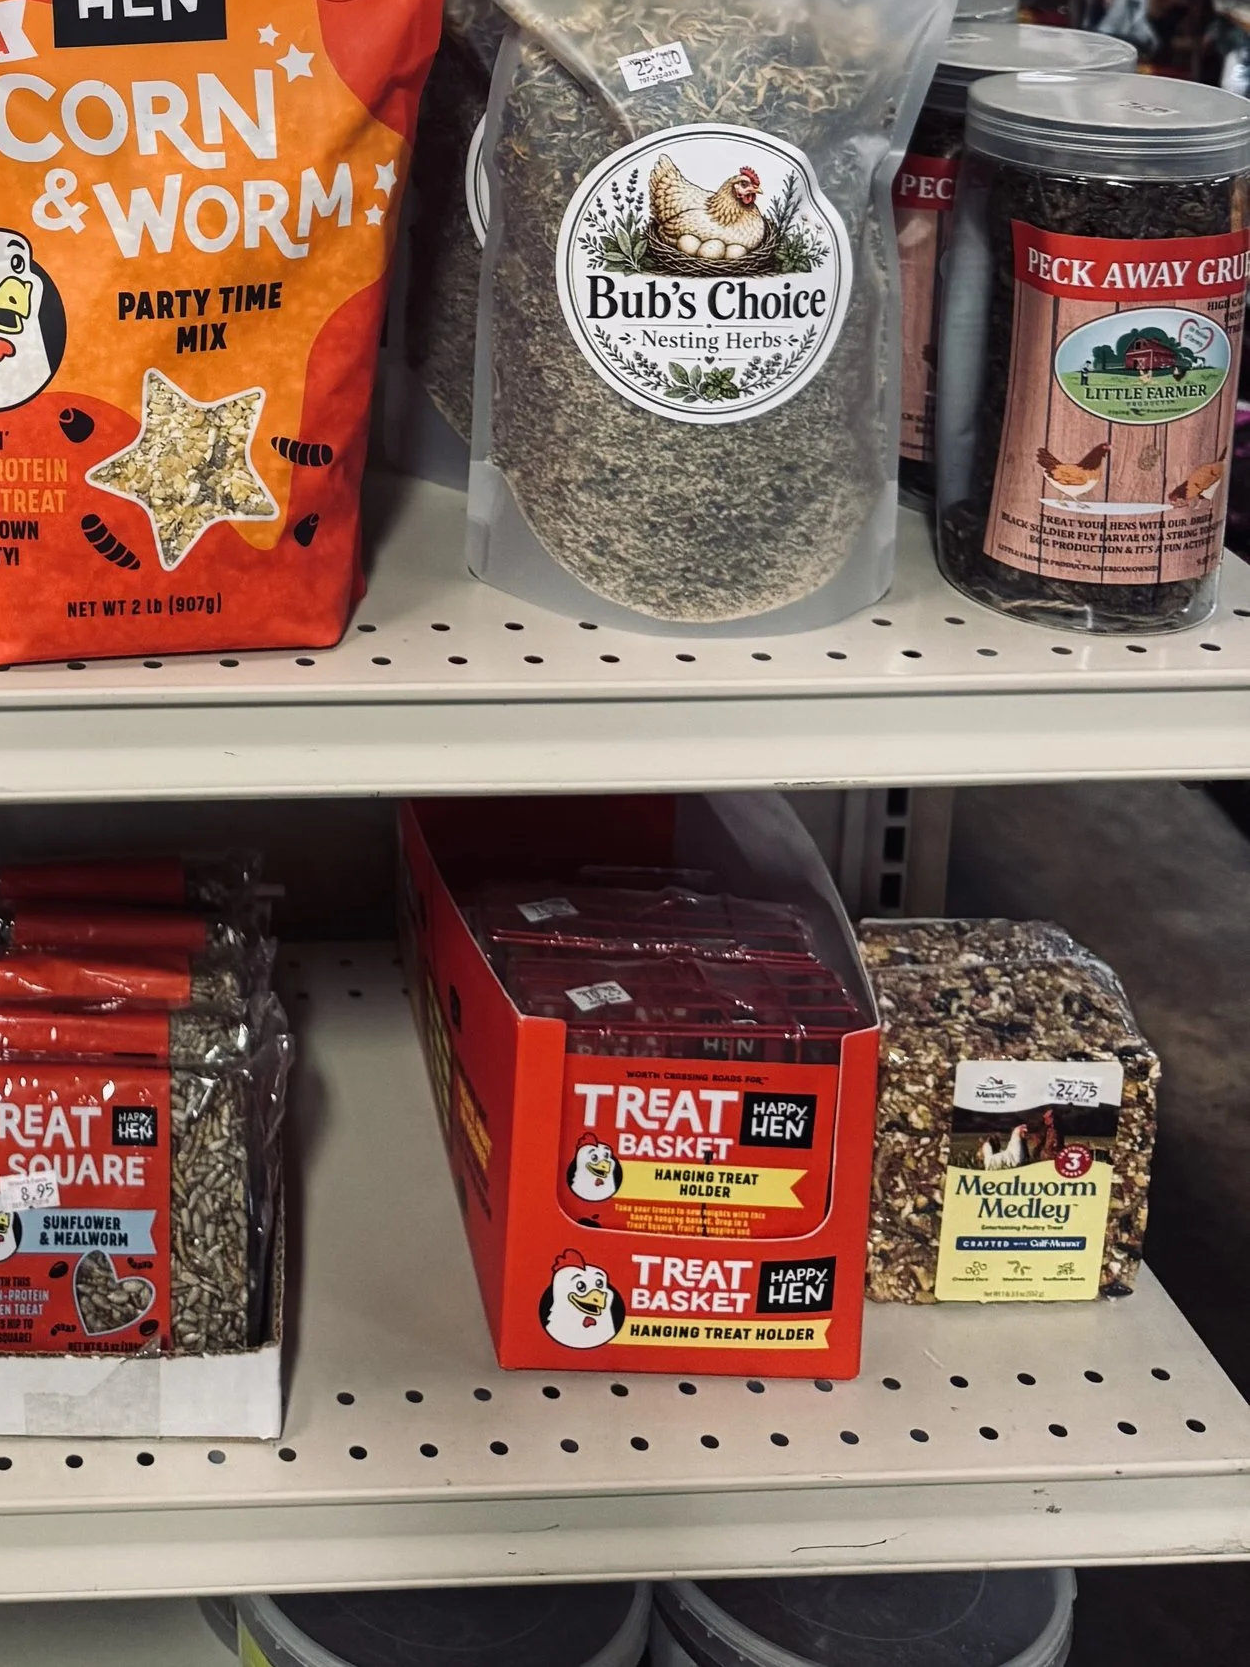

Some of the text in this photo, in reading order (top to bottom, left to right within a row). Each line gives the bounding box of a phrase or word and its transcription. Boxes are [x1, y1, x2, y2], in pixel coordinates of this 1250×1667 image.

[31, 163, 352, 260] & WORM
[1028, 246, 1190, 290] PECK AWAY
[118, 282, 282, 321] PARTY TIME
[587, 276, 826, 319] Bub's Choice
[177, 323, 227, 354] MIX
[641, 330, 783, 354] Nesting Herbs
[1085, 384, 1207, 400] LITTLE FARMER
[1, 485, 66, 514] TREAT
[1040, 513, 1186, 531] TREAT YOUR HENS WITH OUR
[626, 1071, 660, 1079] WORTH
[664, 1072, 708, 1082] CROSSING
[745, 1076, 764, 1085] FOR
[1056, 1083, 1098, 1098] 24.75
[574, 1083, 739, 1134] TREAT
[753, 1101, 808, 1121] HAPPY
[751, 1116, 805, 1141] HEN
[618, 1133, 733, 1160] BASKET
[655, 1169, 759, 1185] HANGING TREAT
[956, 1175, 1096, 1197] Mealworm
[21, 1183, 54, 1201] 8.95
[679, 1184, 730, 1198] HOLDER
[978, 1198, 1070, 1224] Medley
[43, 1216, 120, 1230] SUNFLOWER
[40, 1232, 128, 1246] & MEALWORM
[631, 1254, 753, 1290] TREAT
[770, 1267, 828, 1287] HAPPY
[631, 1287, 751, 1313] BASKET
[768, 1281, 825, 1306] HEN
[14, 1304, 43, 1315] TREAT
[630, 1323, 814, 1340] HANGING TREAT HOLDER
